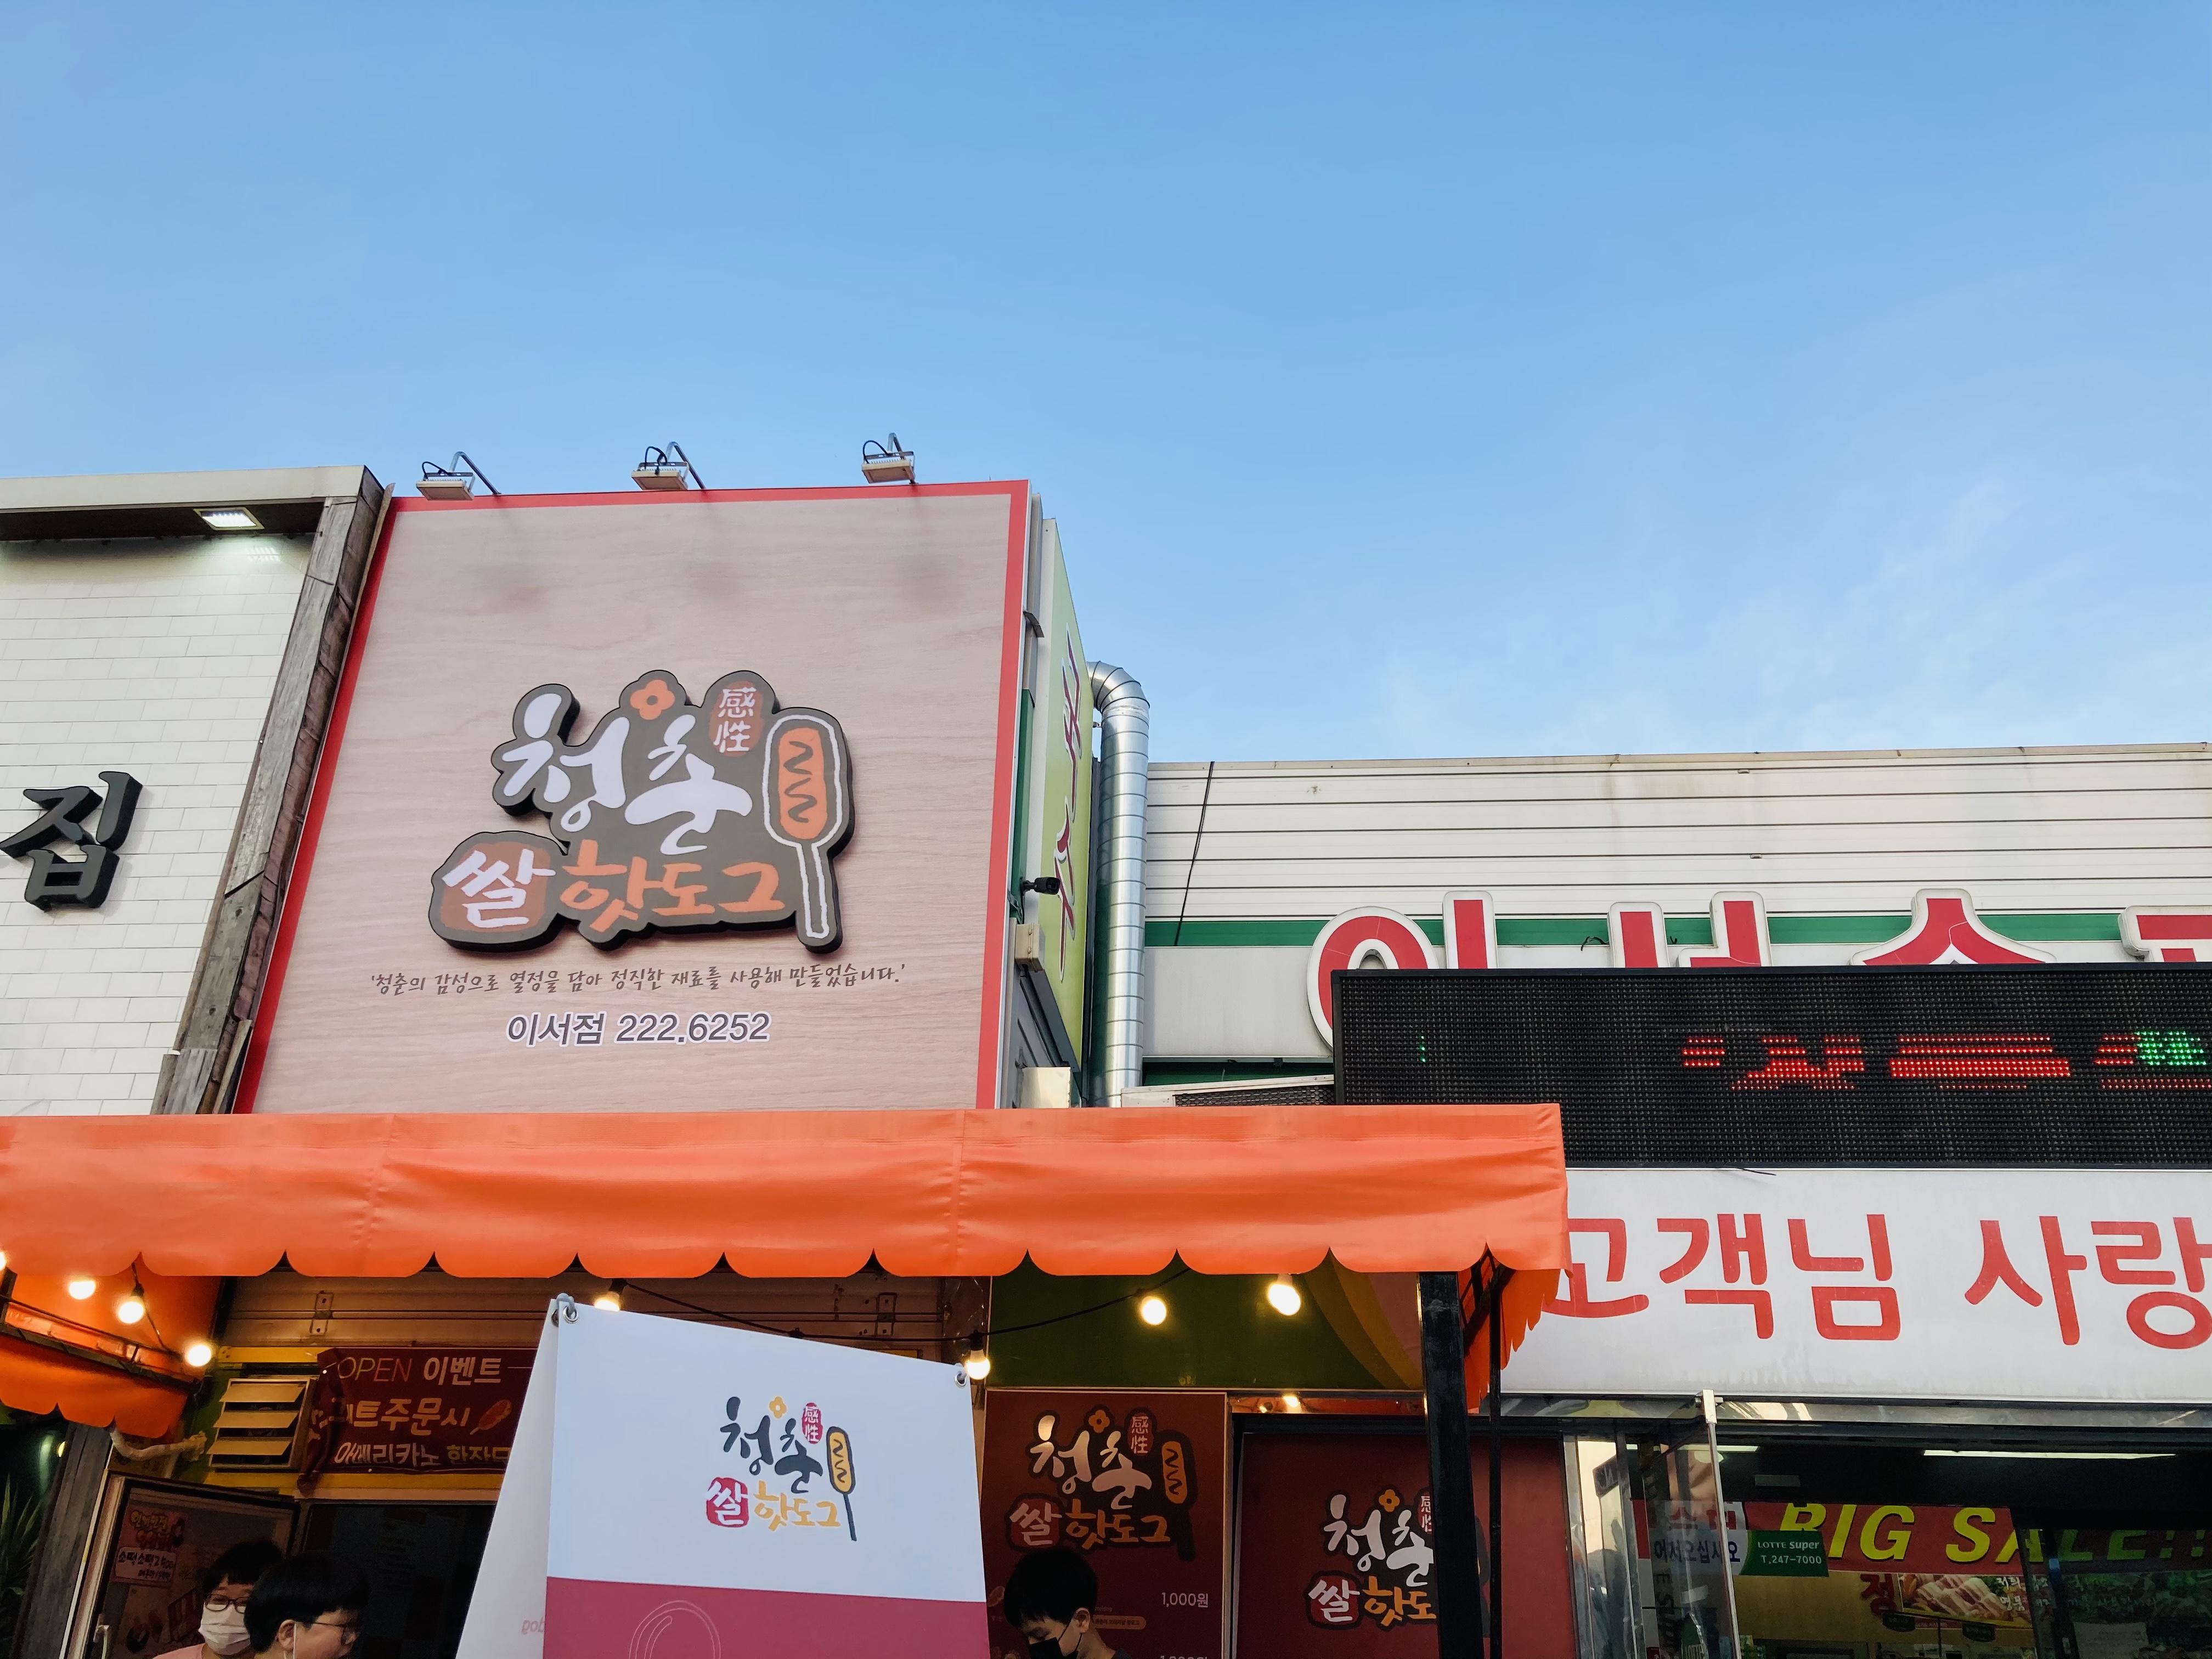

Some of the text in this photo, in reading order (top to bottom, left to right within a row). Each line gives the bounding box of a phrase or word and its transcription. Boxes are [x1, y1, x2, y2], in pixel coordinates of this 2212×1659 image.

[714, 687, 756, 753] 感性
[502, 680, 752, 855] 청춘
[0, 771, 142, 911] 집
[435, 972, 499, 995] 감성으로
[510, 970, 560, 993] 열정을
[568, 972, 603, 992] 담아
[611, 968, 664, 990] 정직한
[671, 966, 722, 990] 재료를
[730, 966, 782, 989] 사용해
[507, 1012, 771, 1046] 이서점 222.6252
[1542, 1214, 2212, 1349] 고객님 사랑
[337, 1356, 501, 1386] OPEN 이벤트
[720, 1396, 823, 1493] 청춘
[1030, 1409, 1152, 1510] 청춘
[1780, 1503, 1915, 1561] BIG
[1161, 1592, 1209, 1608] 1,000원
[1362, 1576, 1437, 1627] 핫도
